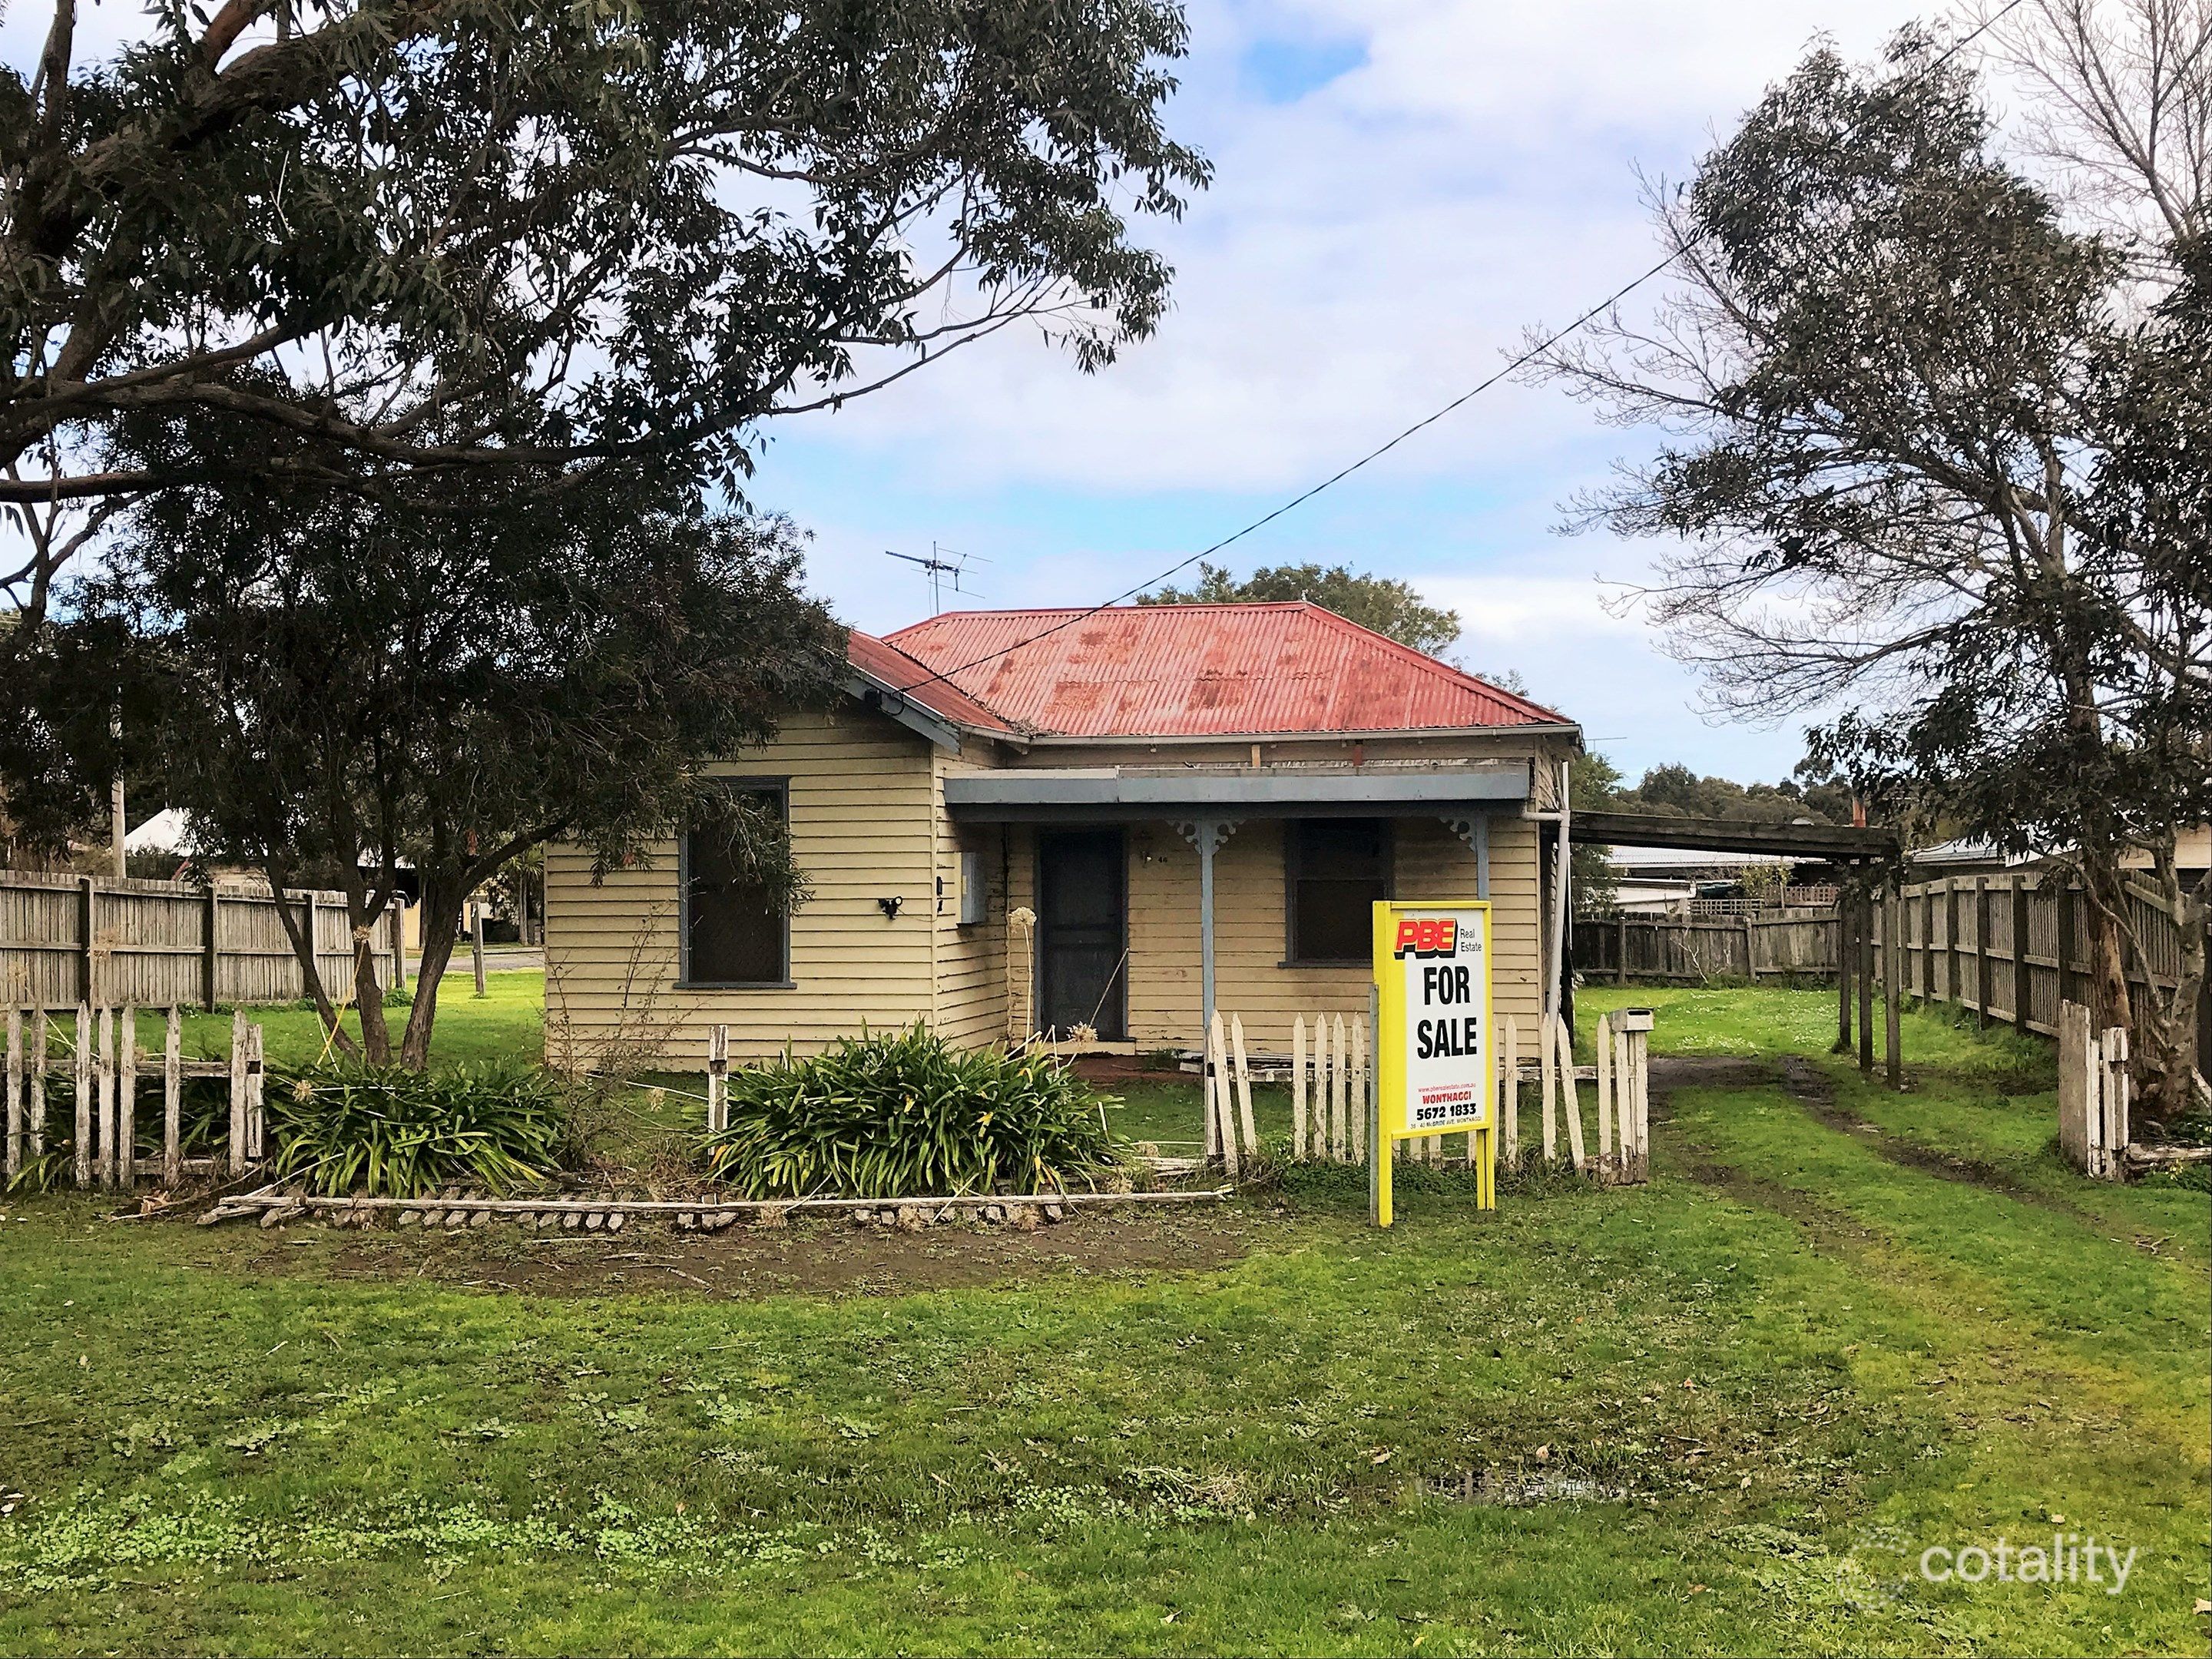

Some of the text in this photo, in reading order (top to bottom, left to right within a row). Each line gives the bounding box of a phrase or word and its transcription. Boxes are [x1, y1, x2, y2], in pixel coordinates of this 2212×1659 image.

[1394, 919, 1456, 955] PBE
[1460, 929, 1475, 939] Real
[1461, 942, 1482, 952] Estate
[1423, 965, 1470, 1005] FOR
[1417, 1017, 1477, 1059] SALE
[1422, 1091, 1472, 1104] WONTHAGGI
[1416, 1103, 1476, 1121] 5672 1833
